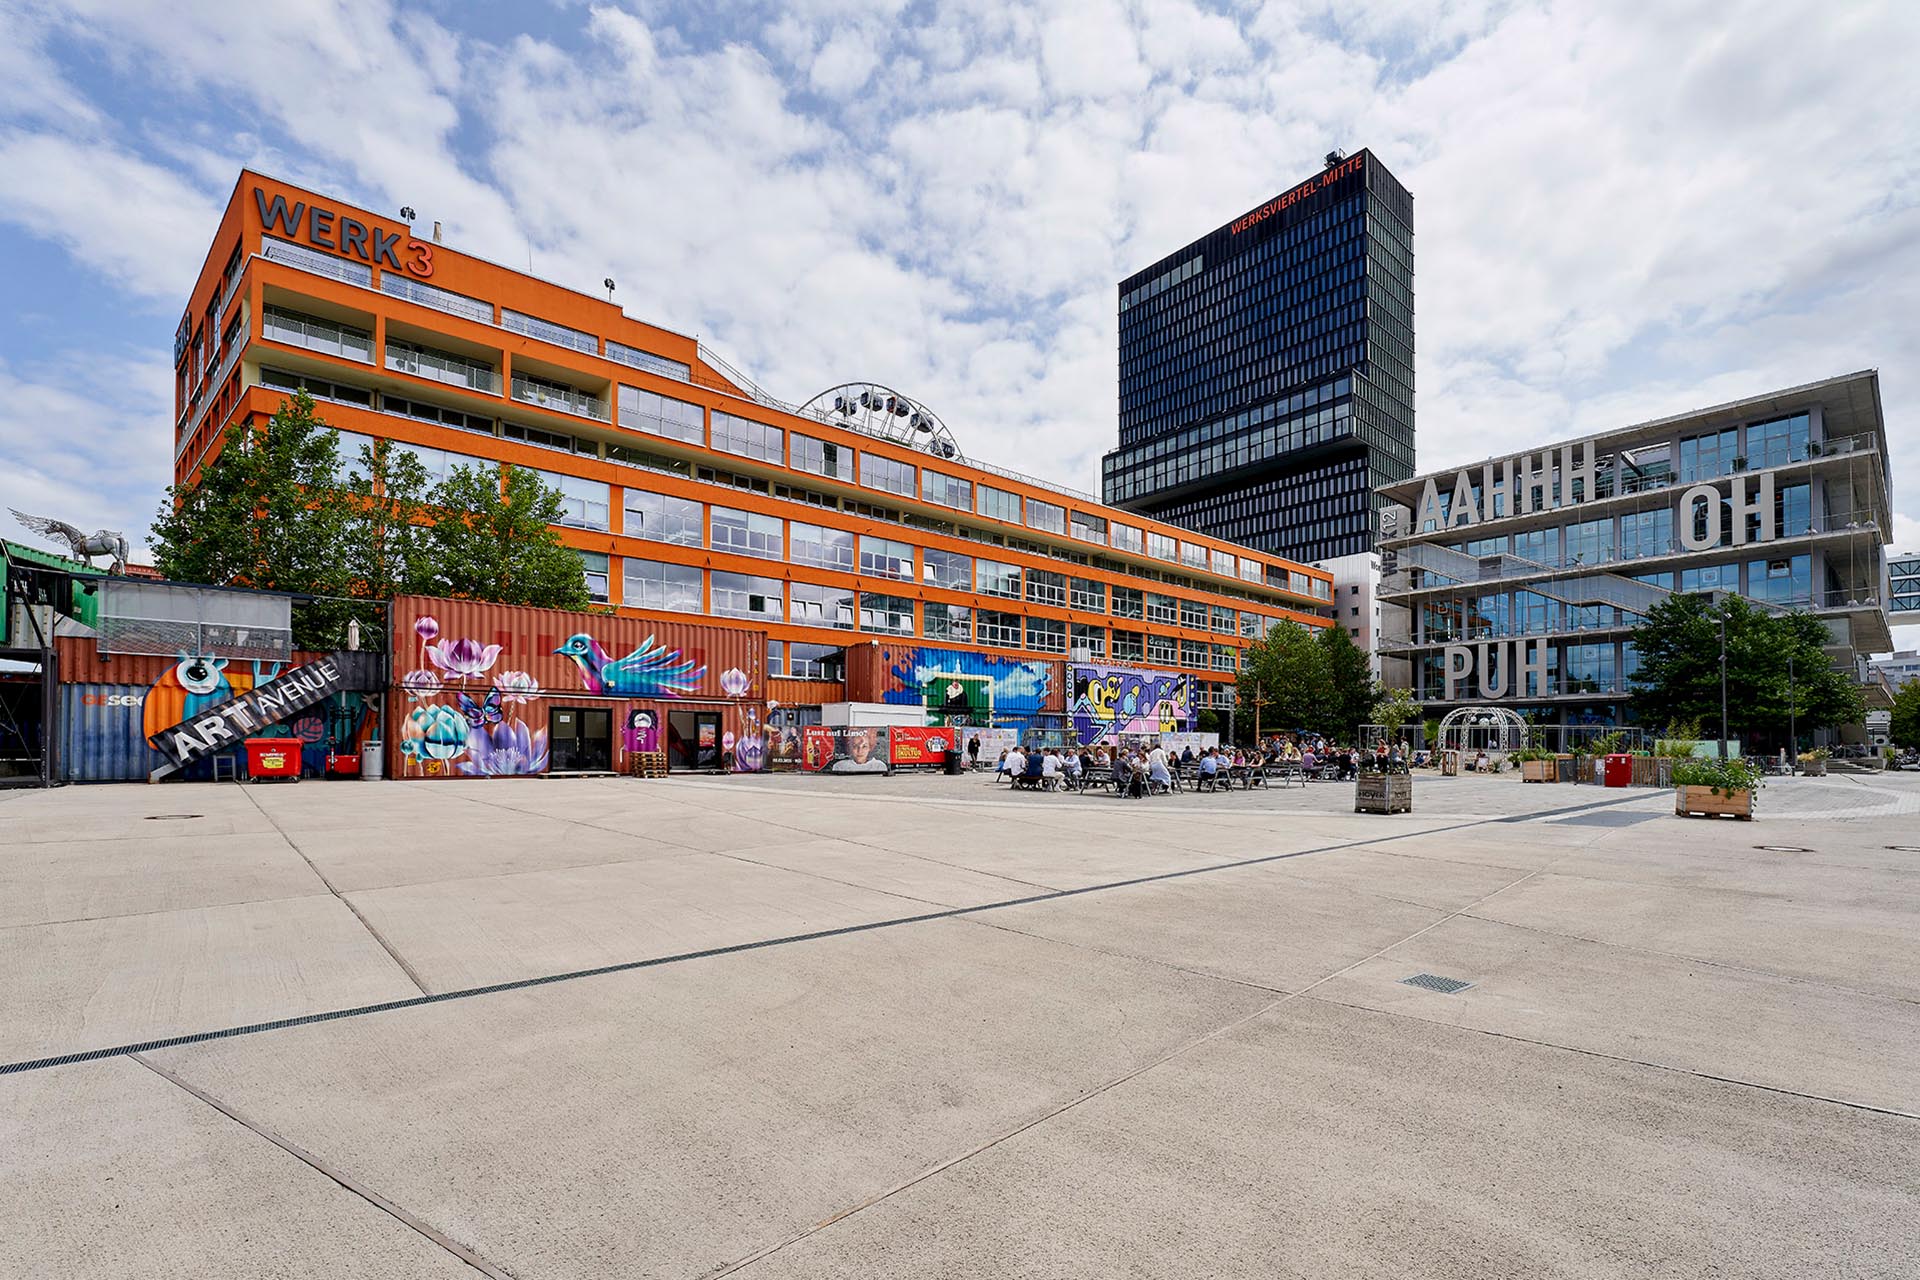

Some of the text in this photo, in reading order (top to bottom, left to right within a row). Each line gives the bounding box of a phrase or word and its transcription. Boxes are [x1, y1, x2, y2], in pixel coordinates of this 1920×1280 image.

[1231, 155, 1363, 235] WERKSVIERTEL-MITTE
[1416, 441, 1596, 533] AAHHH
[1680, 473, 1775, 551] OH
[1446, 639, 1547, 700] PUH
[175, 662, 340, 759] ART AVENUE
[806, 729, 825, 737] Lust
[826, 729, 841, 737] auf
